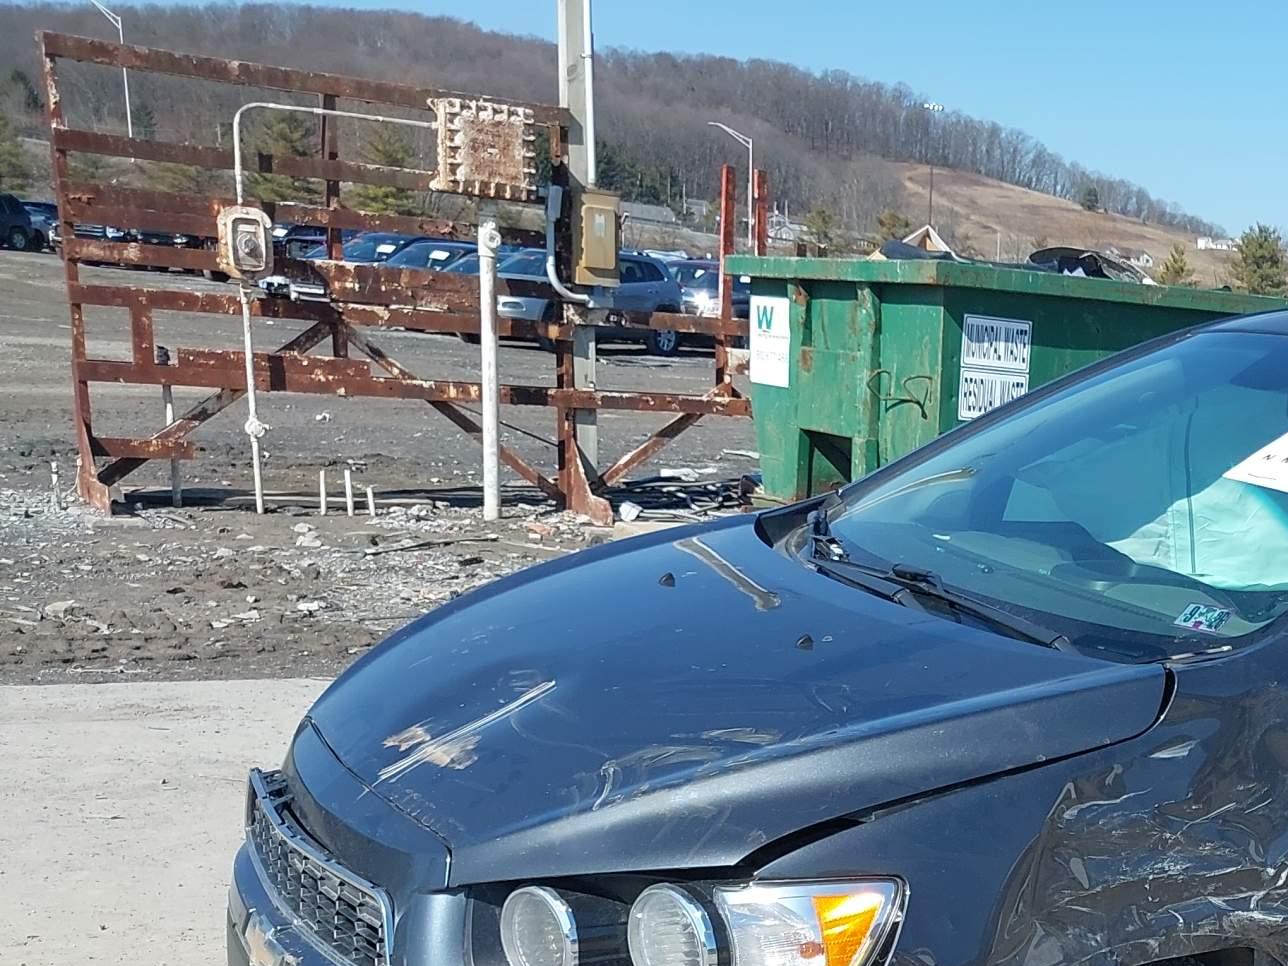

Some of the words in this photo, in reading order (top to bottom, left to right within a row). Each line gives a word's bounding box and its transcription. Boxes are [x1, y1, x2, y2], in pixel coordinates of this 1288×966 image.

[757, 305, 774, 330] W
[966, 323, 1002, 361] MUNICIPAL
[1004, 327, 1028, 363] WASTE
